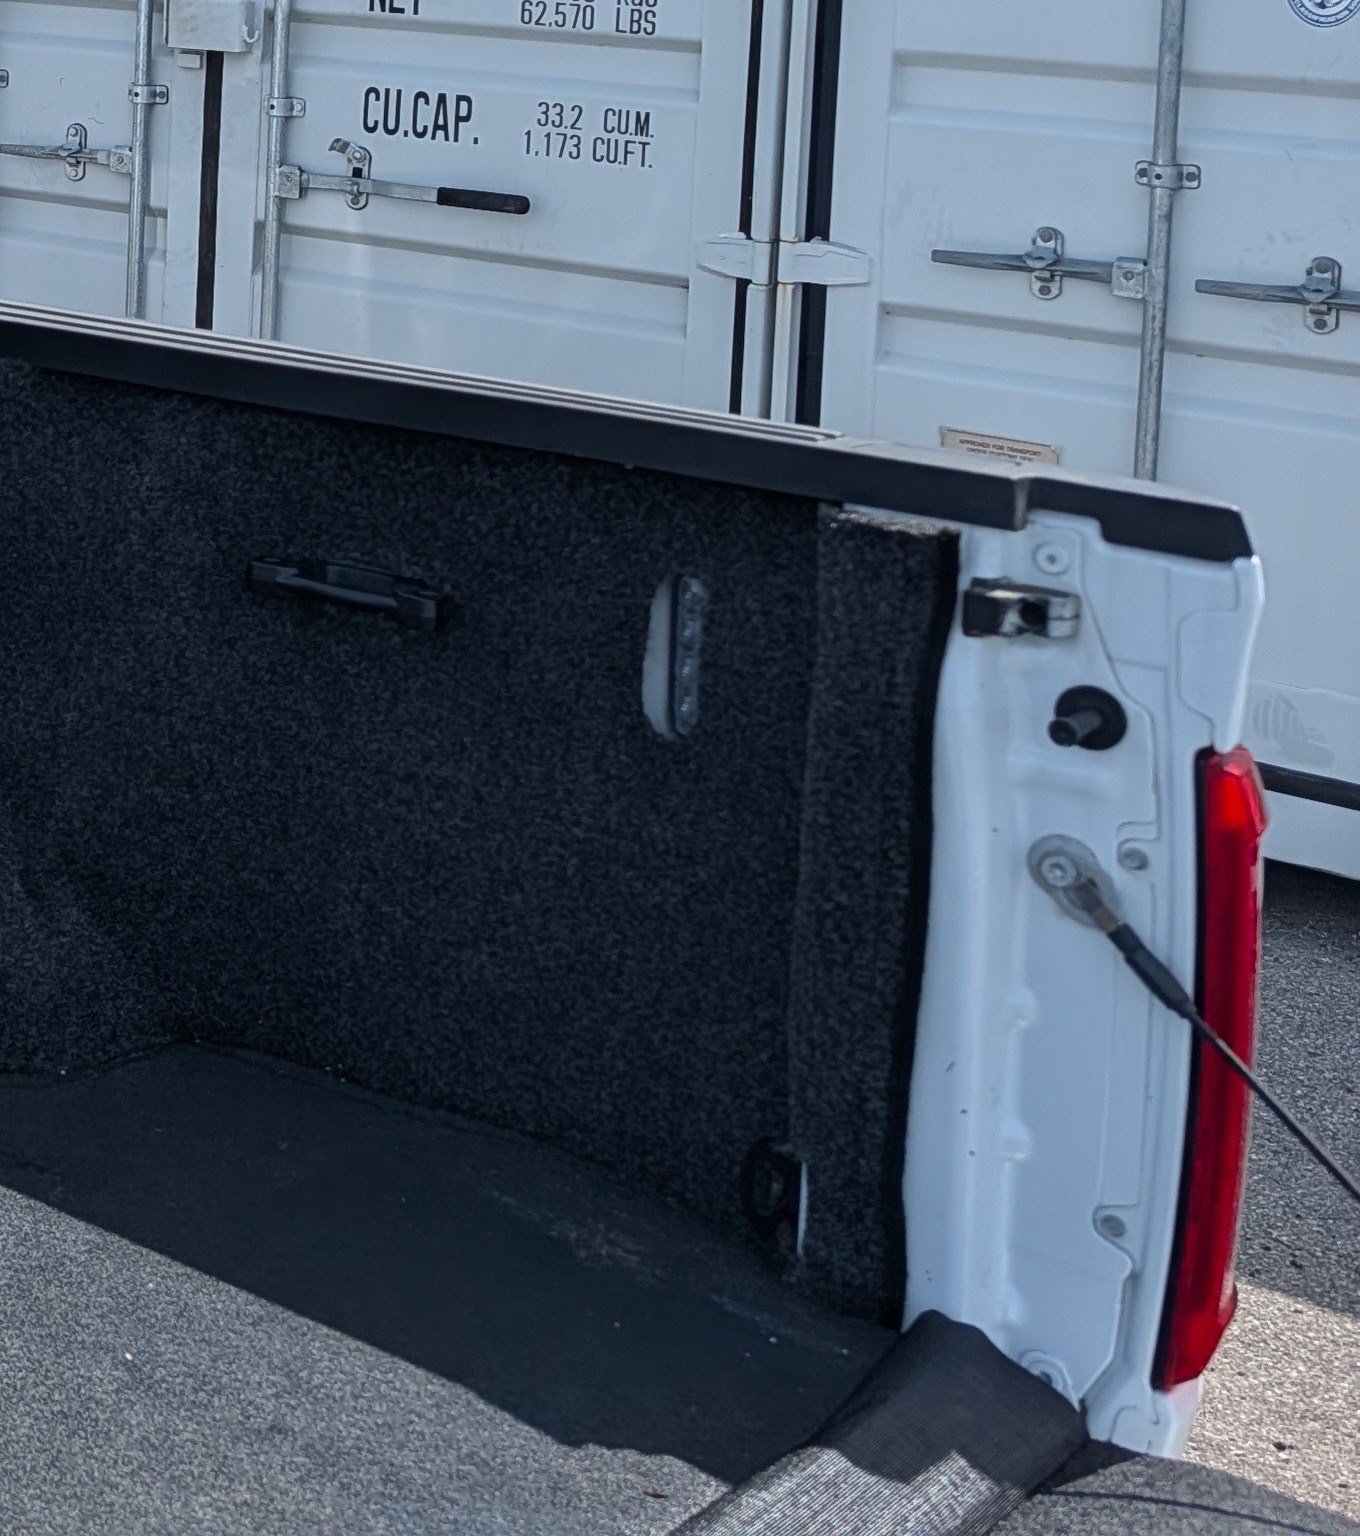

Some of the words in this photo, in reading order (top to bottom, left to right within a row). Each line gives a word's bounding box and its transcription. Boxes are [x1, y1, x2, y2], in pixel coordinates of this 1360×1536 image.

[615, 7, 656, 36] LBS
[362, 86, 479, 146] CU.CAP.
[536, 101, 584, 130] 33.2
[603, 107, 655, 138] CU.M.
[592, 136, 653, 169] CU.FT.
[992, 443, 1005, 451] FOR
[1007, 446, 1042, 457] TRANSPORT
